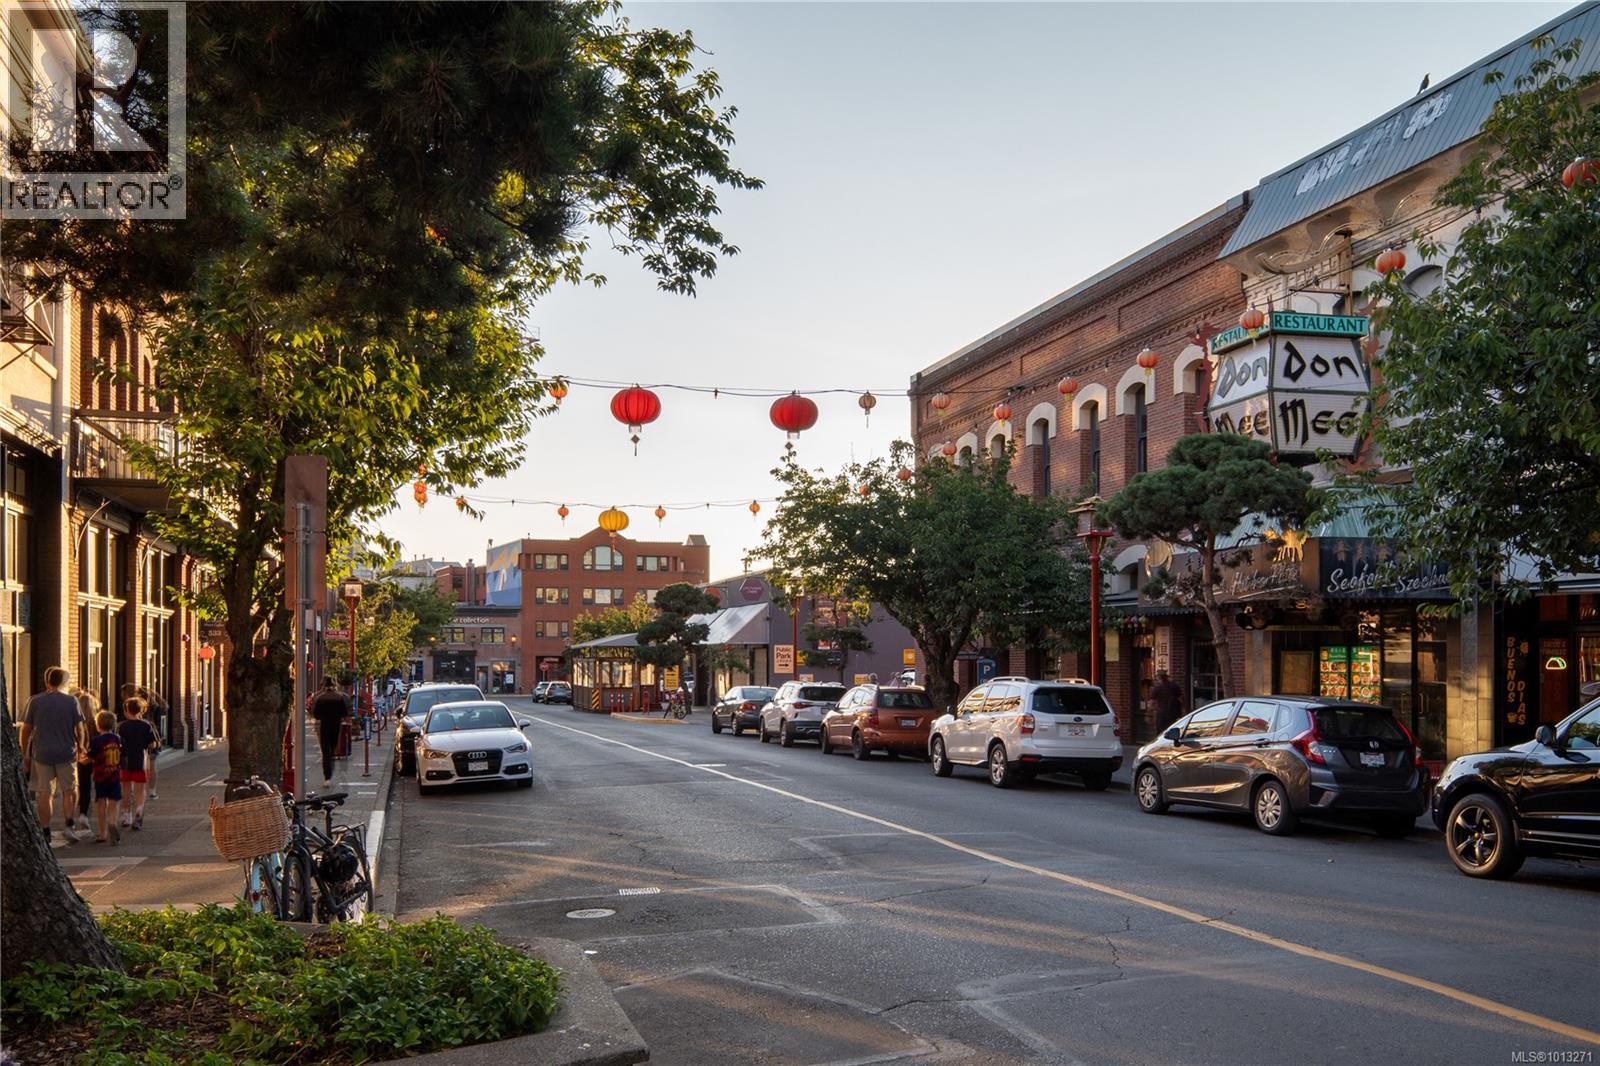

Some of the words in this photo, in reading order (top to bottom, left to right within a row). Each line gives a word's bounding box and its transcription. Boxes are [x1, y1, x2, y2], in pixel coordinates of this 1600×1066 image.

[1274, 313, 1366, 333] RESTAURANT
[1217, 356, 1268, 399] Don
[1283, 340, 1360, 383] Don
[1394, 564, 1451, 594] Szechu
[983, 664, 991, 674] P
[1506, 636, 1516, 703] BUENOS
